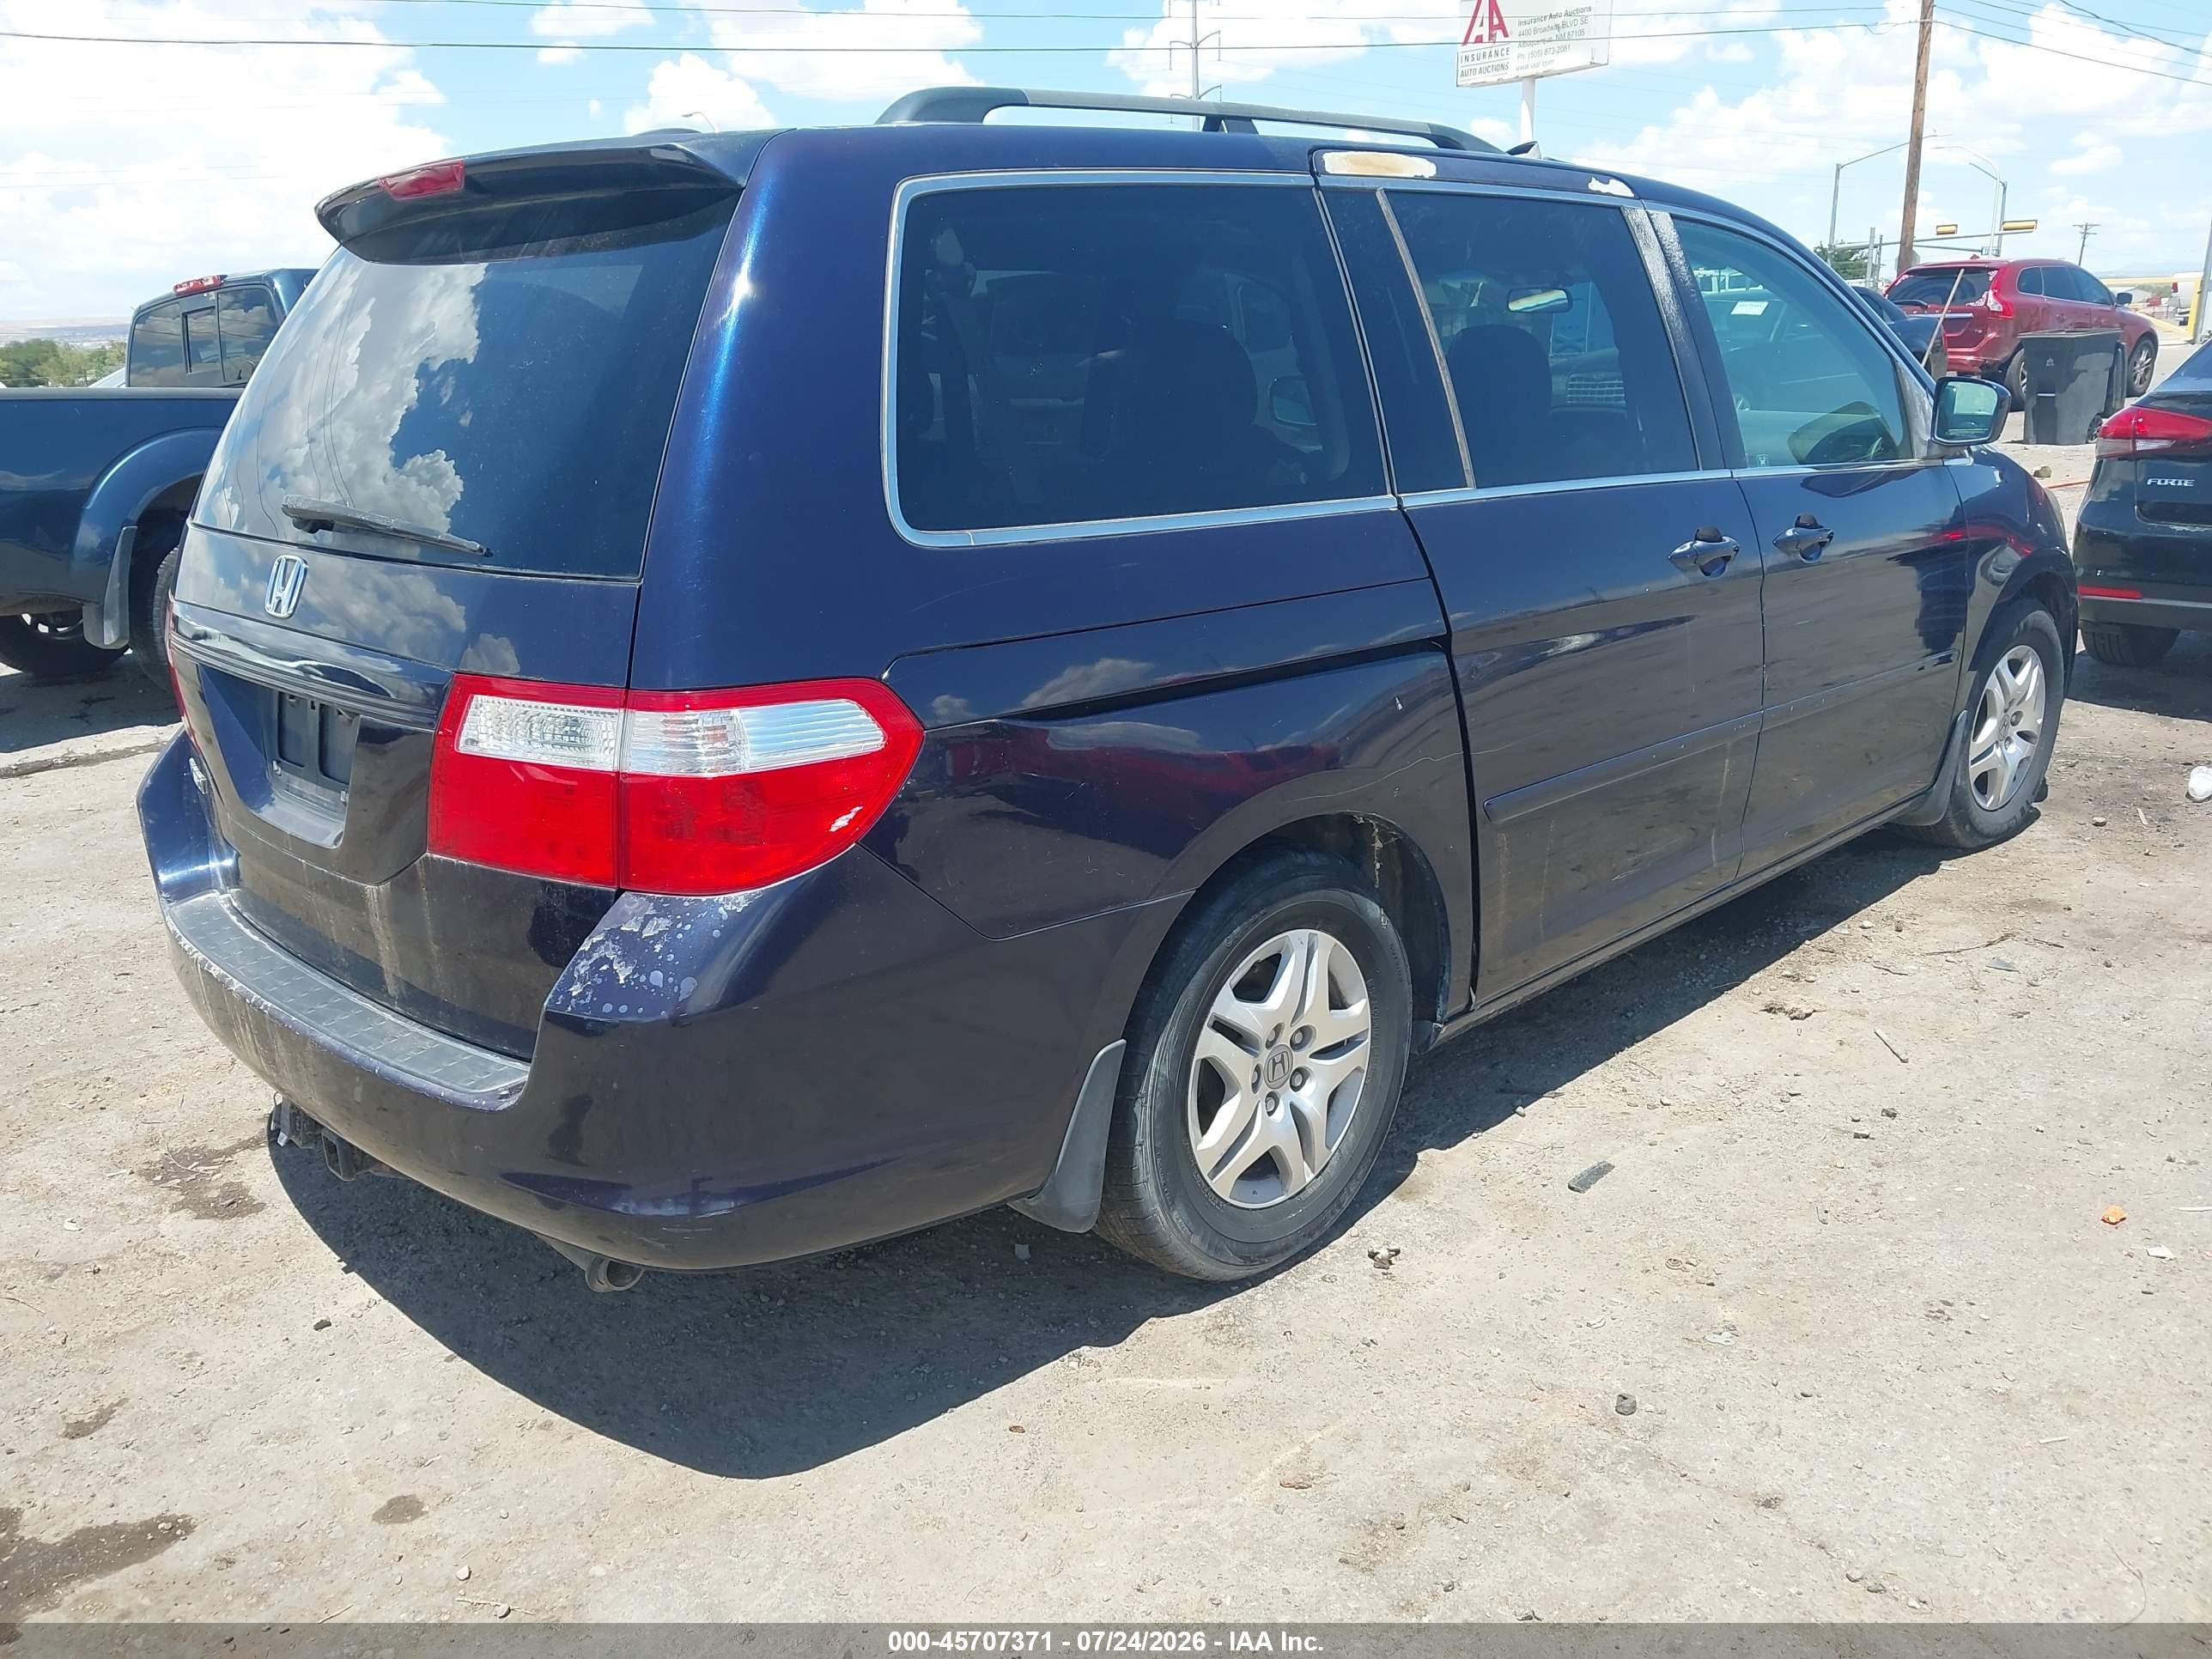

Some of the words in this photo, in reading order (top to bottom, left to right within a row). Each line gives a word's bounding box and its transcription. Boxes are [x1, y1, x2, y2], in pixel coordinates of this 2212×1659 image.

[1548, 12, 1562, 21] Auto
[1564, 6, 1592, 17] Auctions
[1518, 28, 1532, 37] 4400
[1562, 18, 1578, 29] BLVD
[1580, 16, 1589, 25] SE
[1556, 32, 1565, 41] NM
[1567, 28, 1585, 40] 87105
[1461, 46, 1510, 64] INSURANCE
[1461, 67, 1477, 78] AUTO
[1478, 61, 1510, 75] AUCTIONS
[2147, 477, 2195, 487] FORTE
